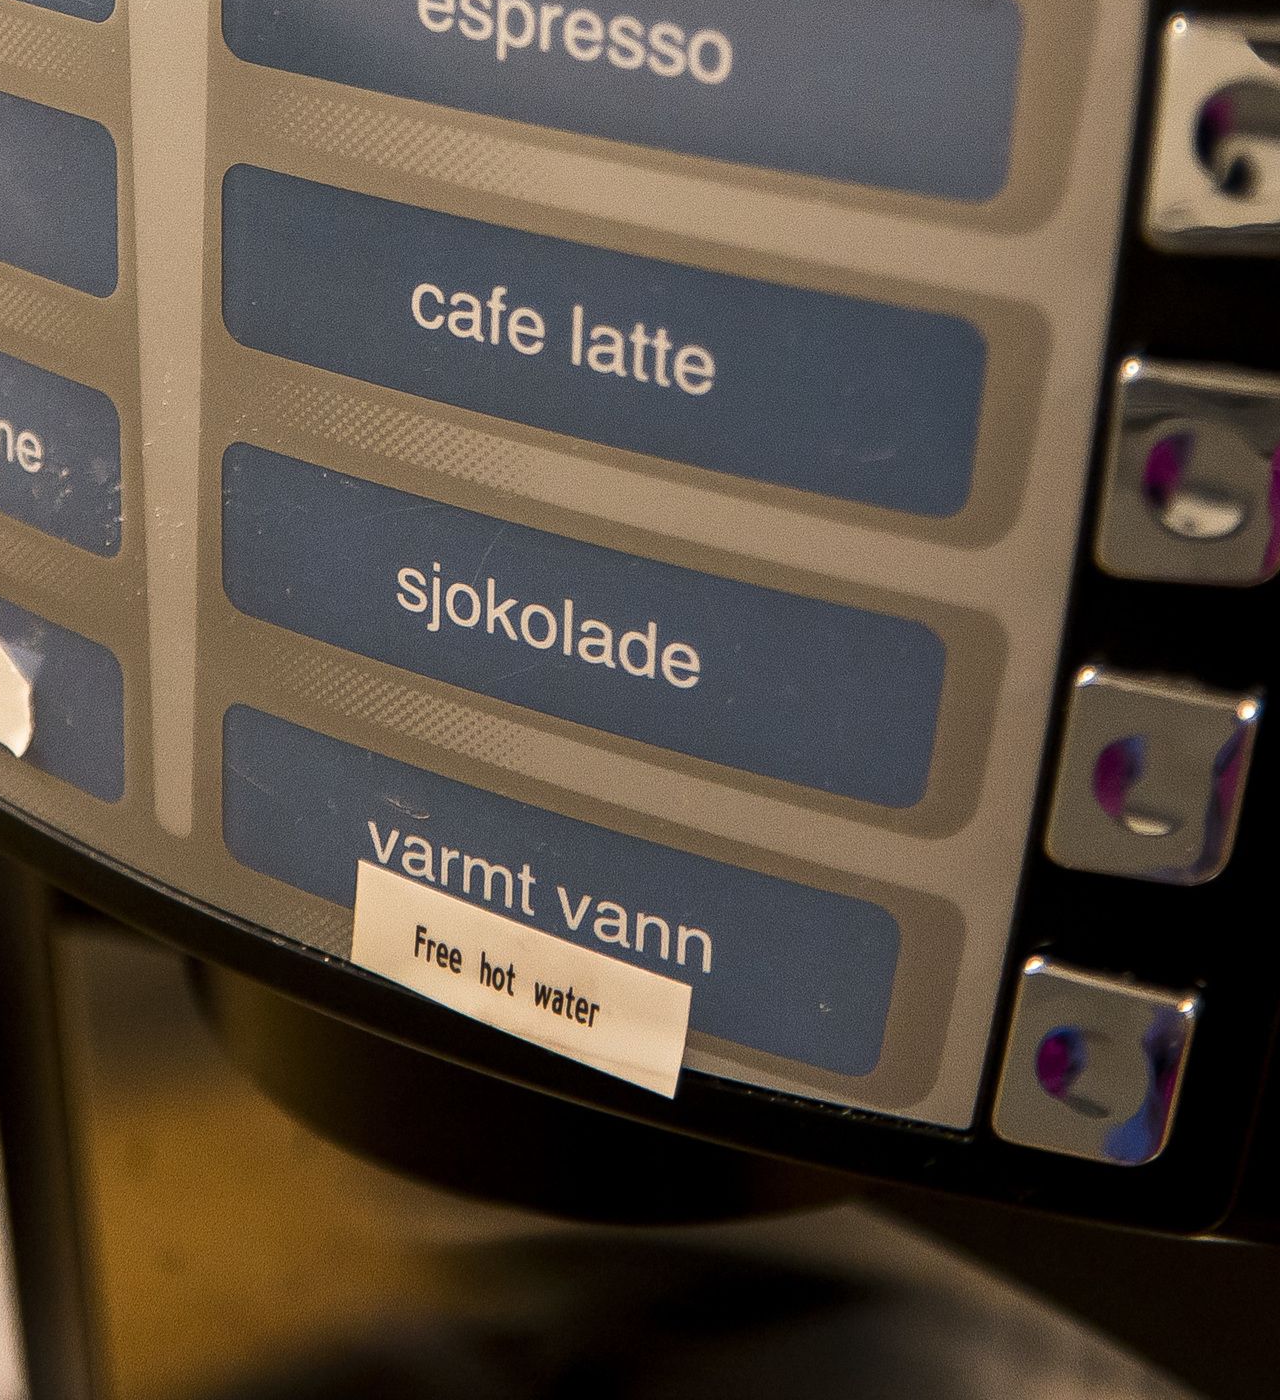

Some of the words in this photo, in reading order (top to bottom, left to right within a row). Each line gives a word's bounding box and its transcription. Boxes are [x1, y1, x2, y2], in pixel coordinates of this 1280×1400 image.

[411, 283, 546, 355] cafe
[571, 304, 717, 397] latte
[396, 562, 701, 689] sjokolade
[367, 820, 536, 916] varmt
[557, 885, 713, 974] vann
[414, 925, 462, 974] Free
[480, 951, 515, 996] hot
[534, 981, 600, 1028] water
